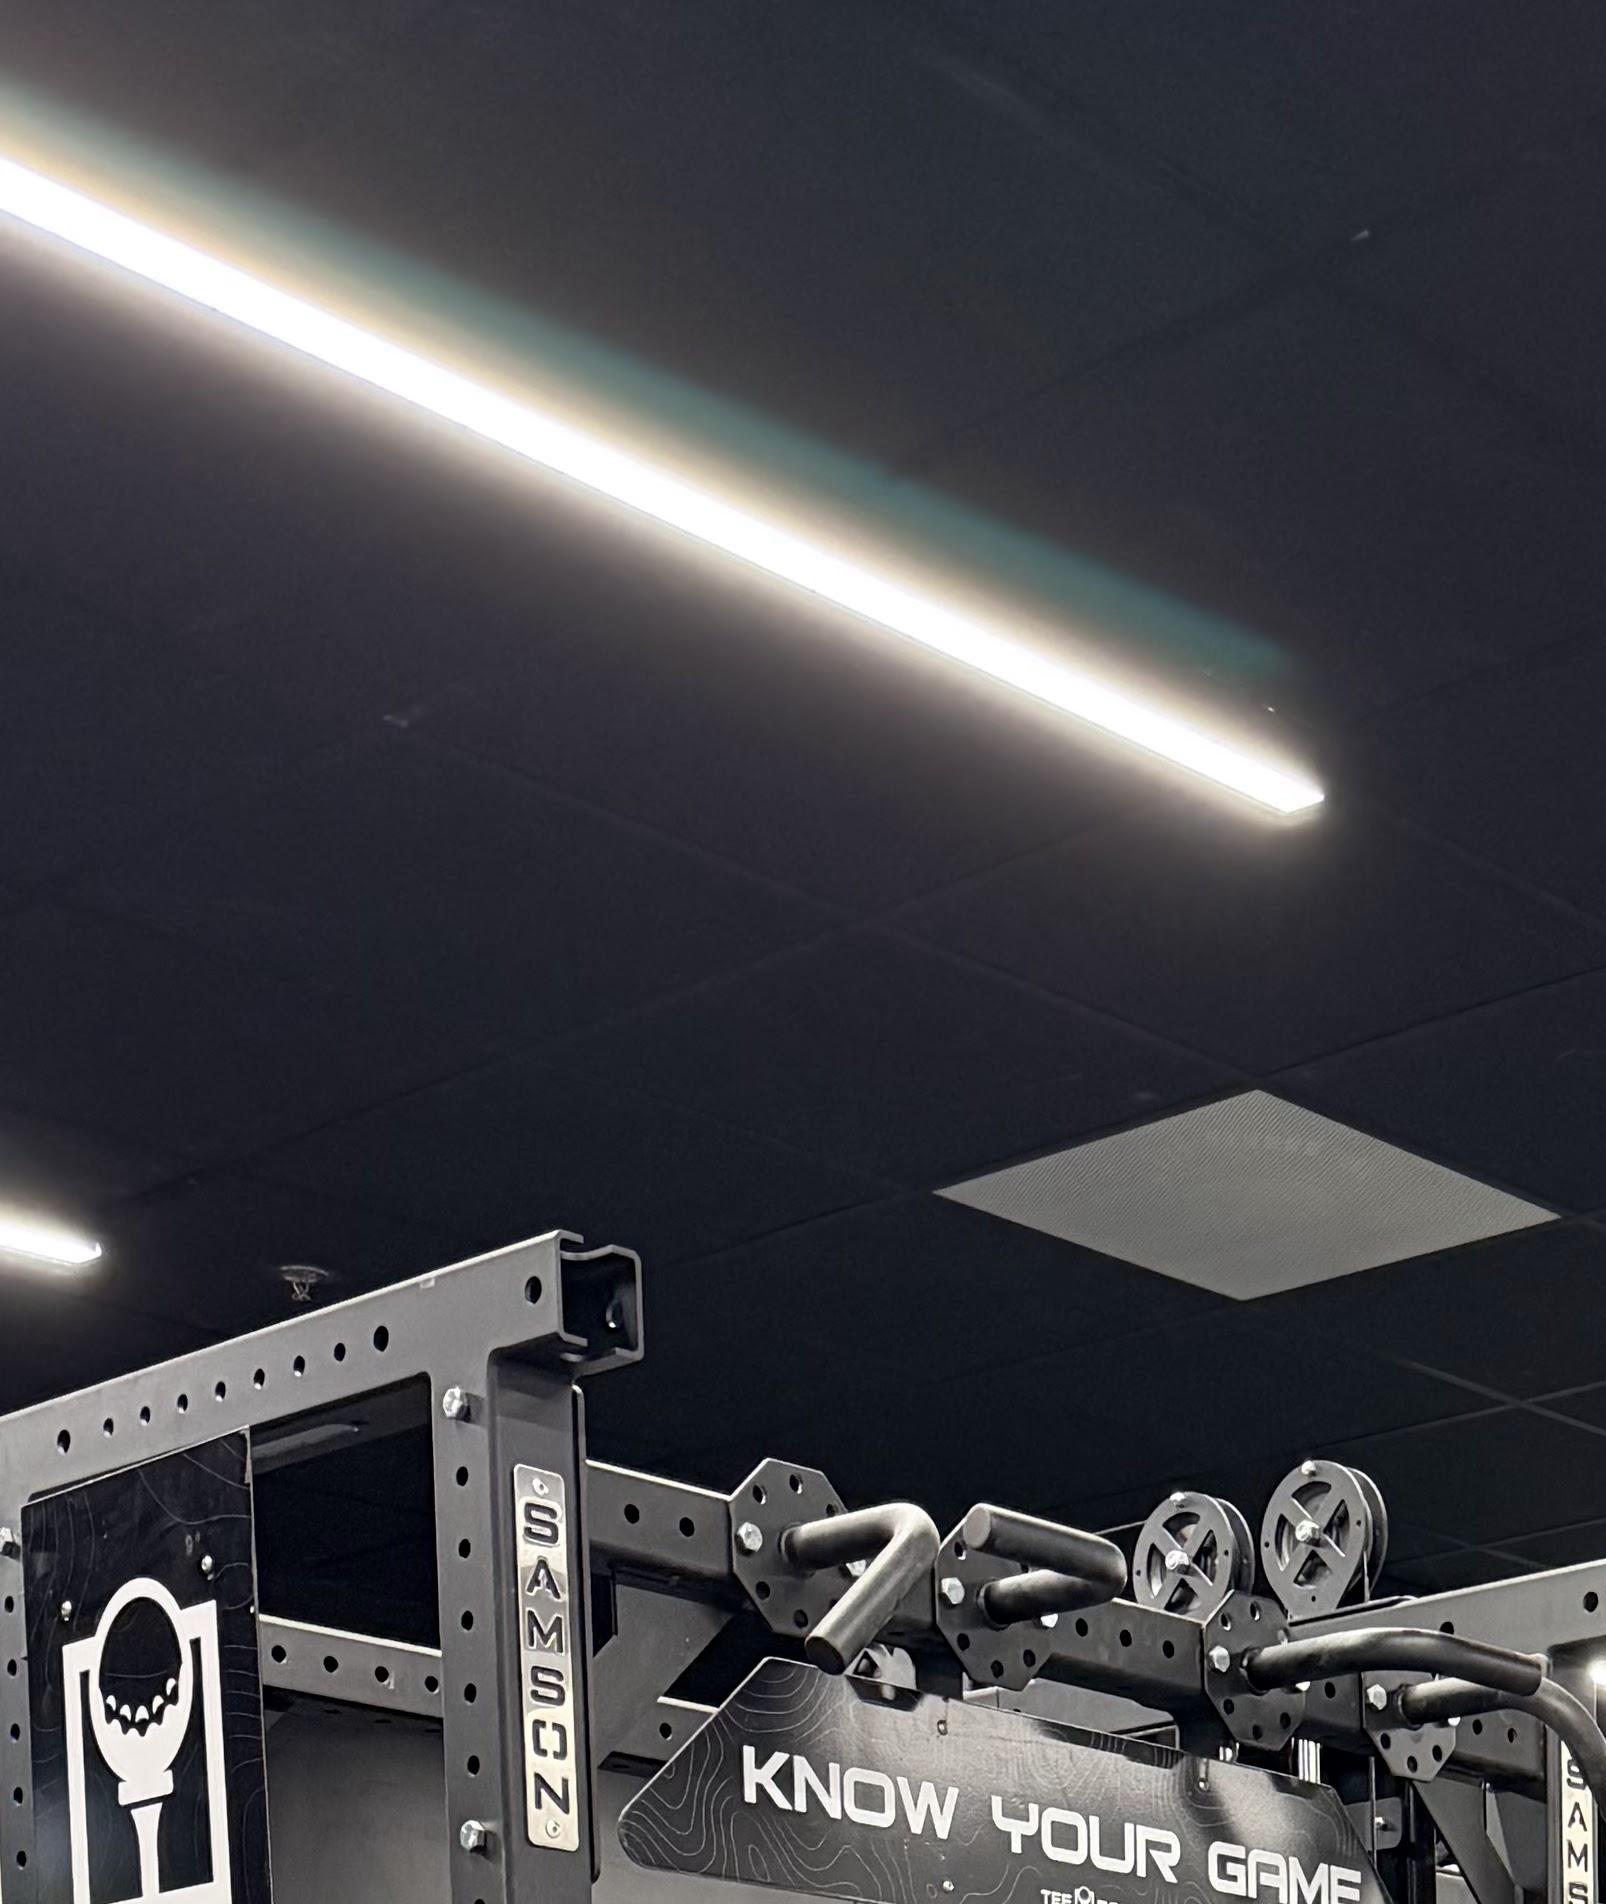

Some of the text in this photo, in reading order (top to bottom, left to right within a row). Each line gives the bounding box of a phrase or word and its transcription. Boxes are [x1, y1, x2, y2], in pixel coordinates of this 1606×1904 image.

[522, 1503, 571, 1816] SAMSON
[743, 1746, 958, 1841] KNOW
[991, 1793, 1180, 1882] YOUR
